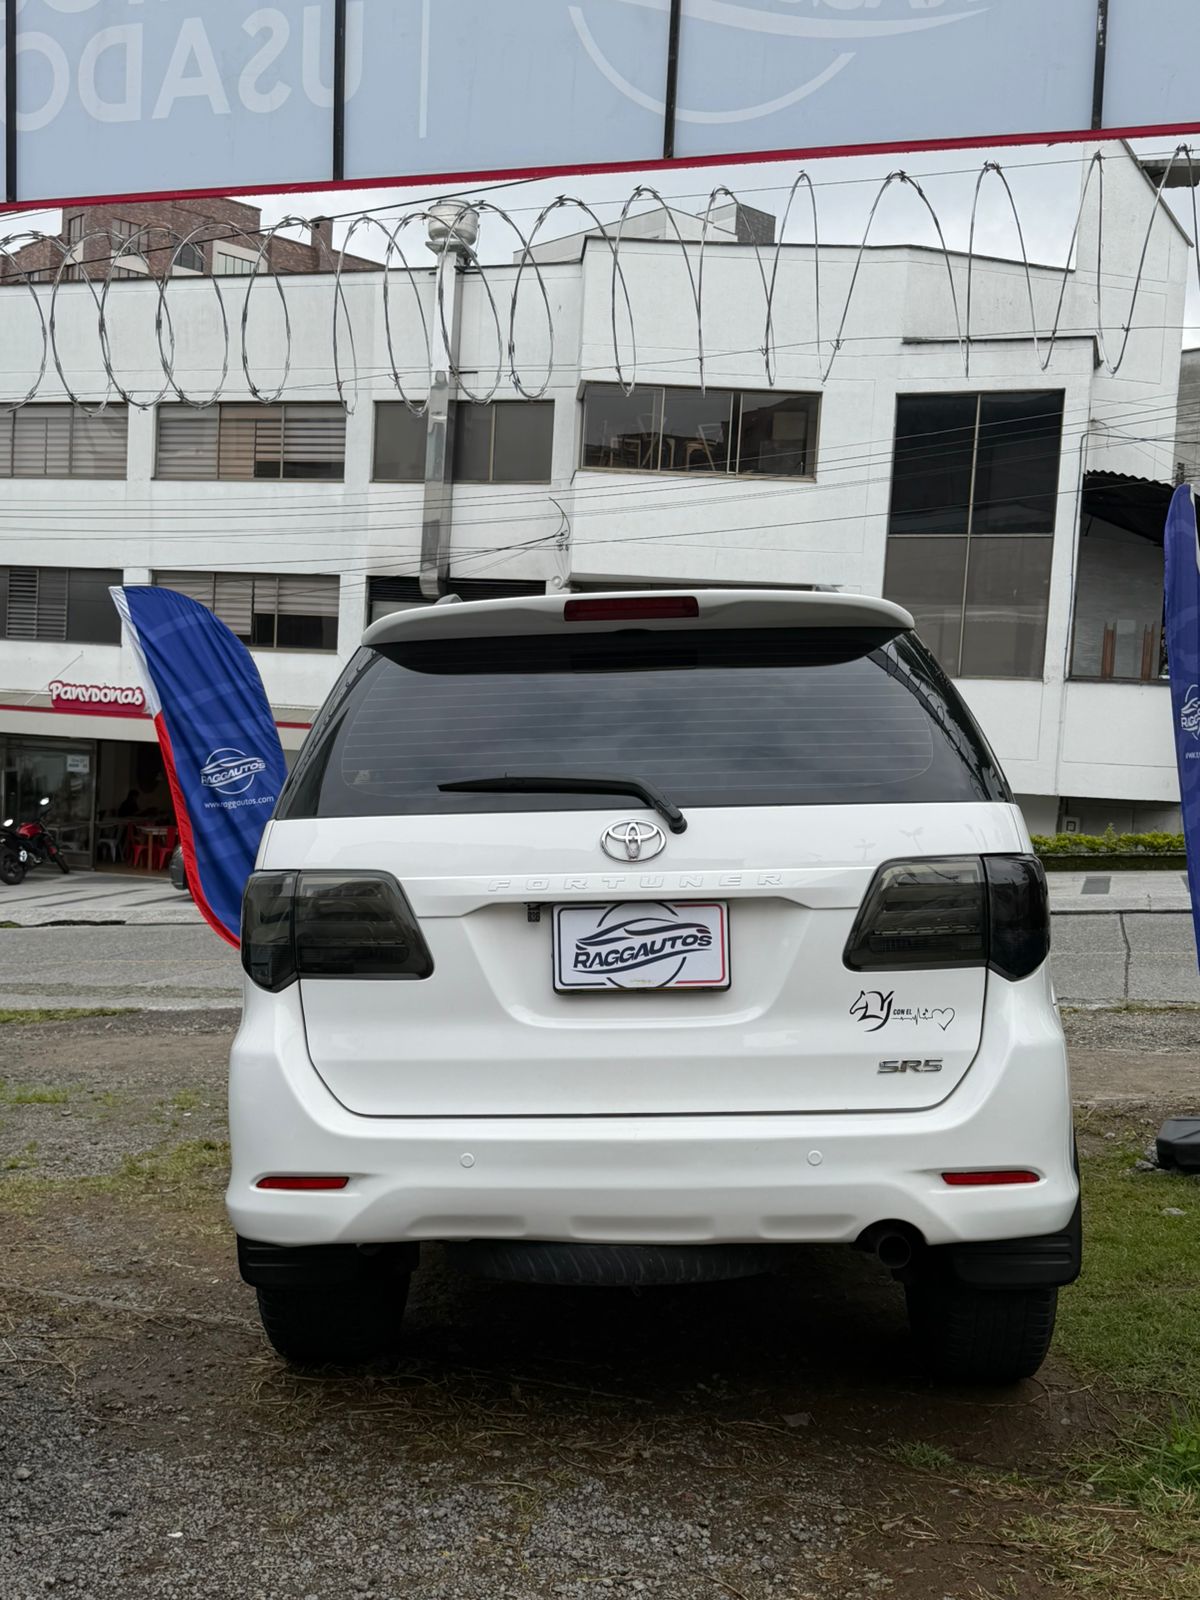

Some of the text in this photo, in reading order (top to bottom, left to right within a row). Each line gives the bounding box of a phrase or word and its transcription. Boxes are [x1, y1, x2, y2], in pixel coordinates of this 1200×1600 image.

[201, 762, 266, 784] RAGGAUTOS
[487, 872, 784, 892] FORTUNER
[573, 934, 712, 969] RAGGAUTOS
[893, 1008, 912, 1016] CON EL
[877, 1059, 943, 1075] SR5
